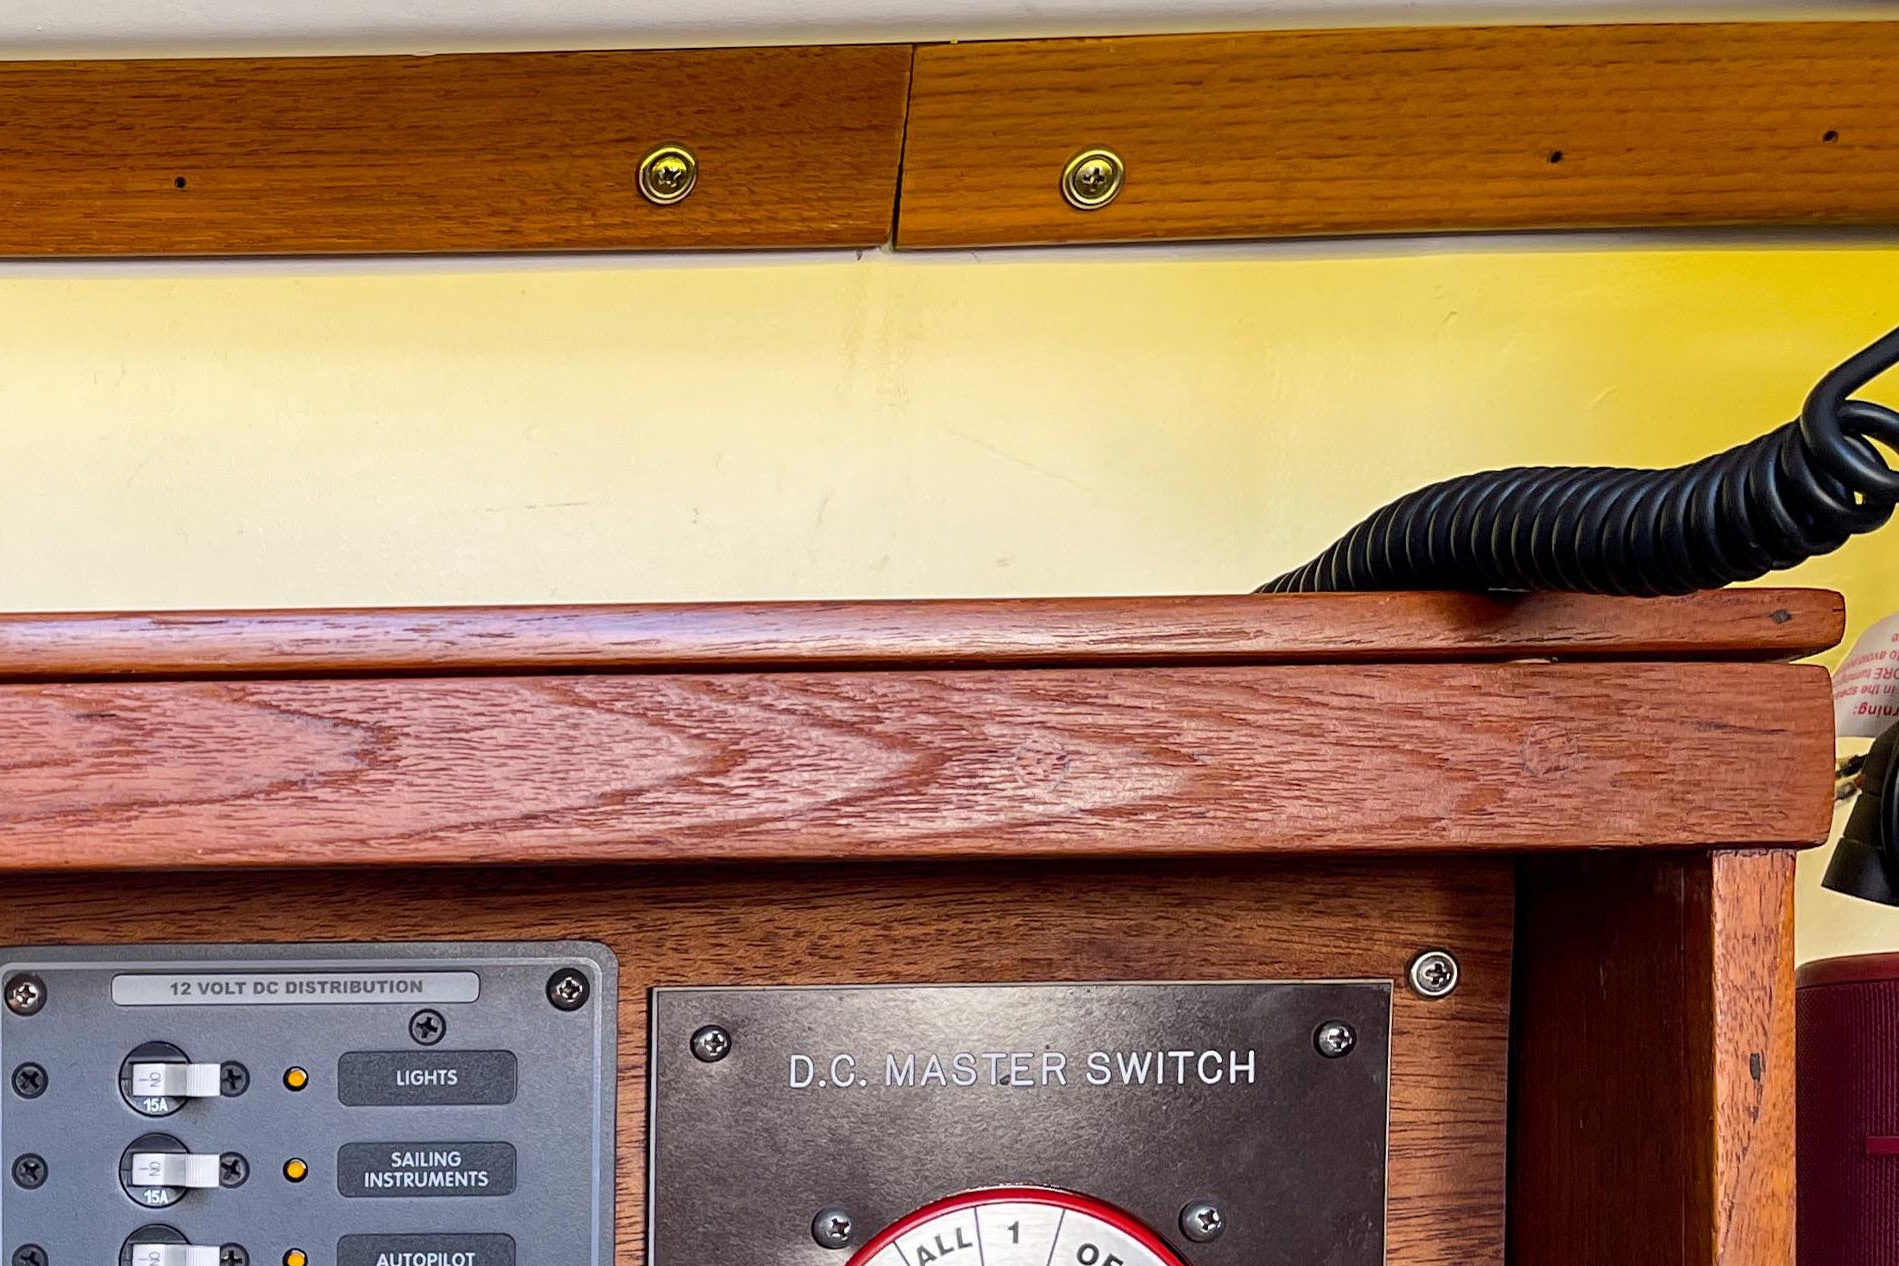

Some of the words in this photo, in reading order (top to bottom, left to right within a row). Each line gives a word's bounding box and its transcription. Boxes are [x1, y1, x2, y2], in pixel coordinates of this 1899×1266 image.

[170, 982, 191, 995] 12
[197, 981, 247, 995] VOLT
[253, 981, 279, 994] DC
[285, 980, 423, 994] DISTRIBUTION
[790, 1054, 867, 1089] D.C.
[885, 1052, 1068, 1086] MASTER
[1086, 1049, 1256, 1085] SWITCH
[149, 1072, 161, 1087] ON
[396, 1069, 458, 1086] LIGHTS
[143, 1098, 168, 1112] 15A
[391, 1151, 461, 1168] SAILING
[149, 1161, 161, 1177] ON
[364, 1170, 489, 1188] INSTRUMENTS
[144, 1189, 168, 1204] 15A
[1007, 1221, 1020, 1244] 1
[148, 1251, 160, 1266] ON
